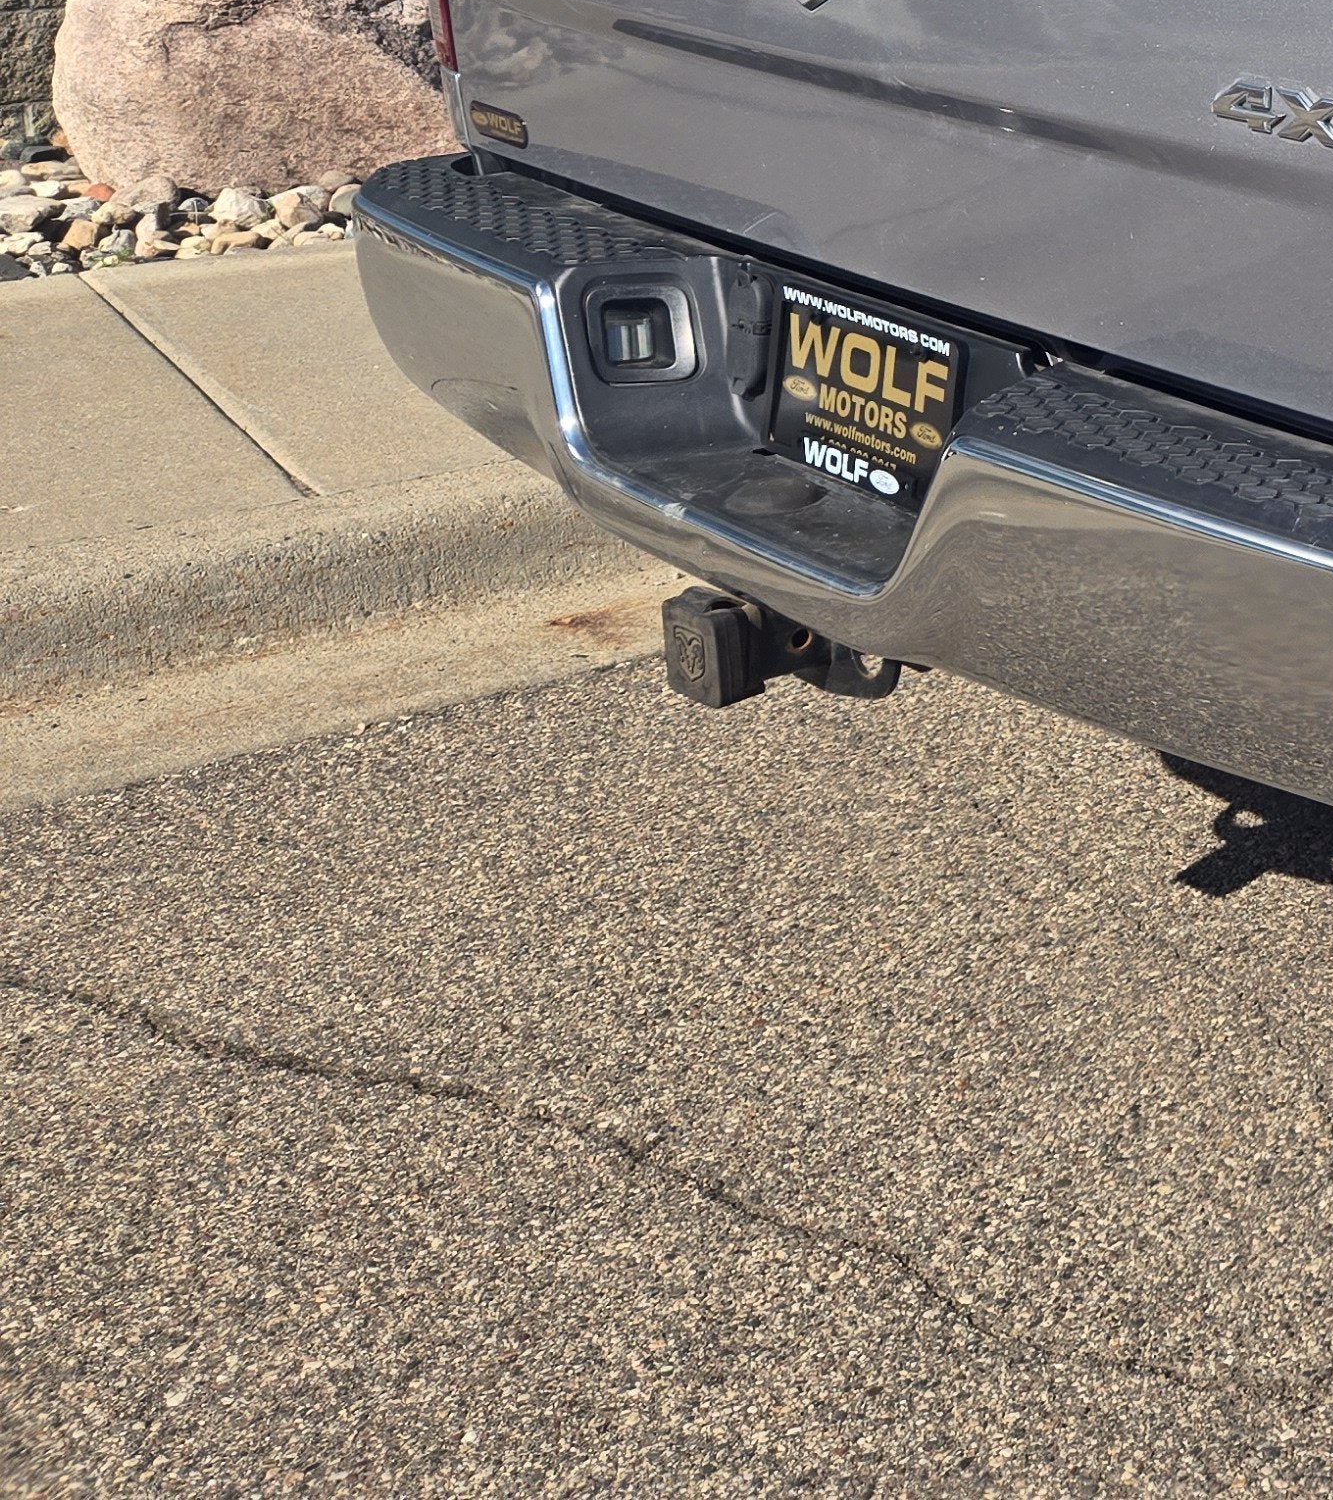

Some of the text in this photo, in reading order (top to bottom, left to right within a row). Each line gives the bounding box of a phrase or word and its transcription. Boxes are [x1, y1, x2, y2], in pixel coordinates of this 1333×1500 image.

[487, 112, 522, 135] WOLF
[783, 286, 950, 356] WWW.WOLFMOTORSCOM
[790, 312, 949, 413] WOLF
[818, 383, 907, 439] MOTORS
[803, 437, 870, 483] WOLF
[805, 412, 917, 465] www.wolfmotors.com
